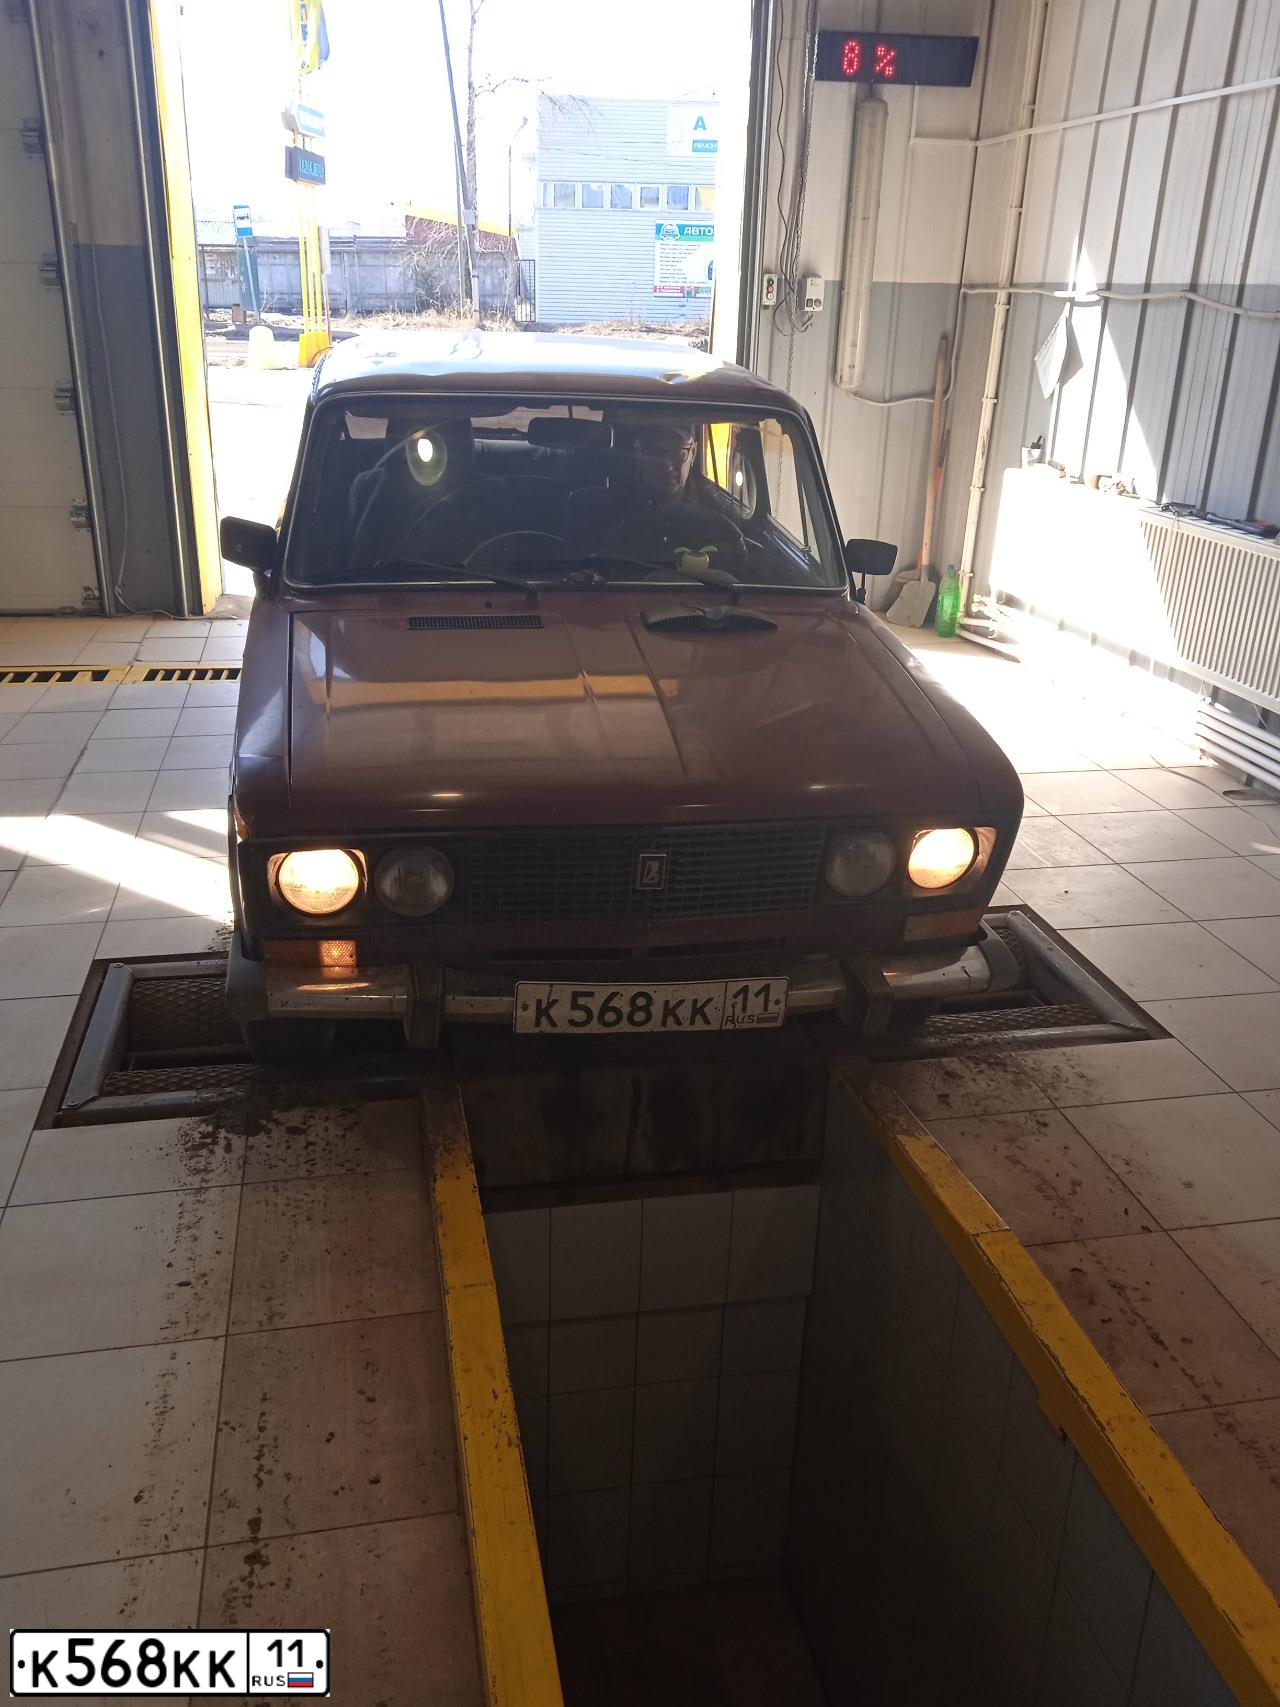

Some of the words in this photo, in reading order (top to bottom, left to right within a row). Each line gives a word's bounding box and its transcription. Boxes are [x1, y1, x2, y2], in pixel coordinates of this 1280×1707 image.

[683, 226, 714, 236] АВТО
[732, 983, 771, 1013] 11
[724, 1014, 756, 1027] RUS
